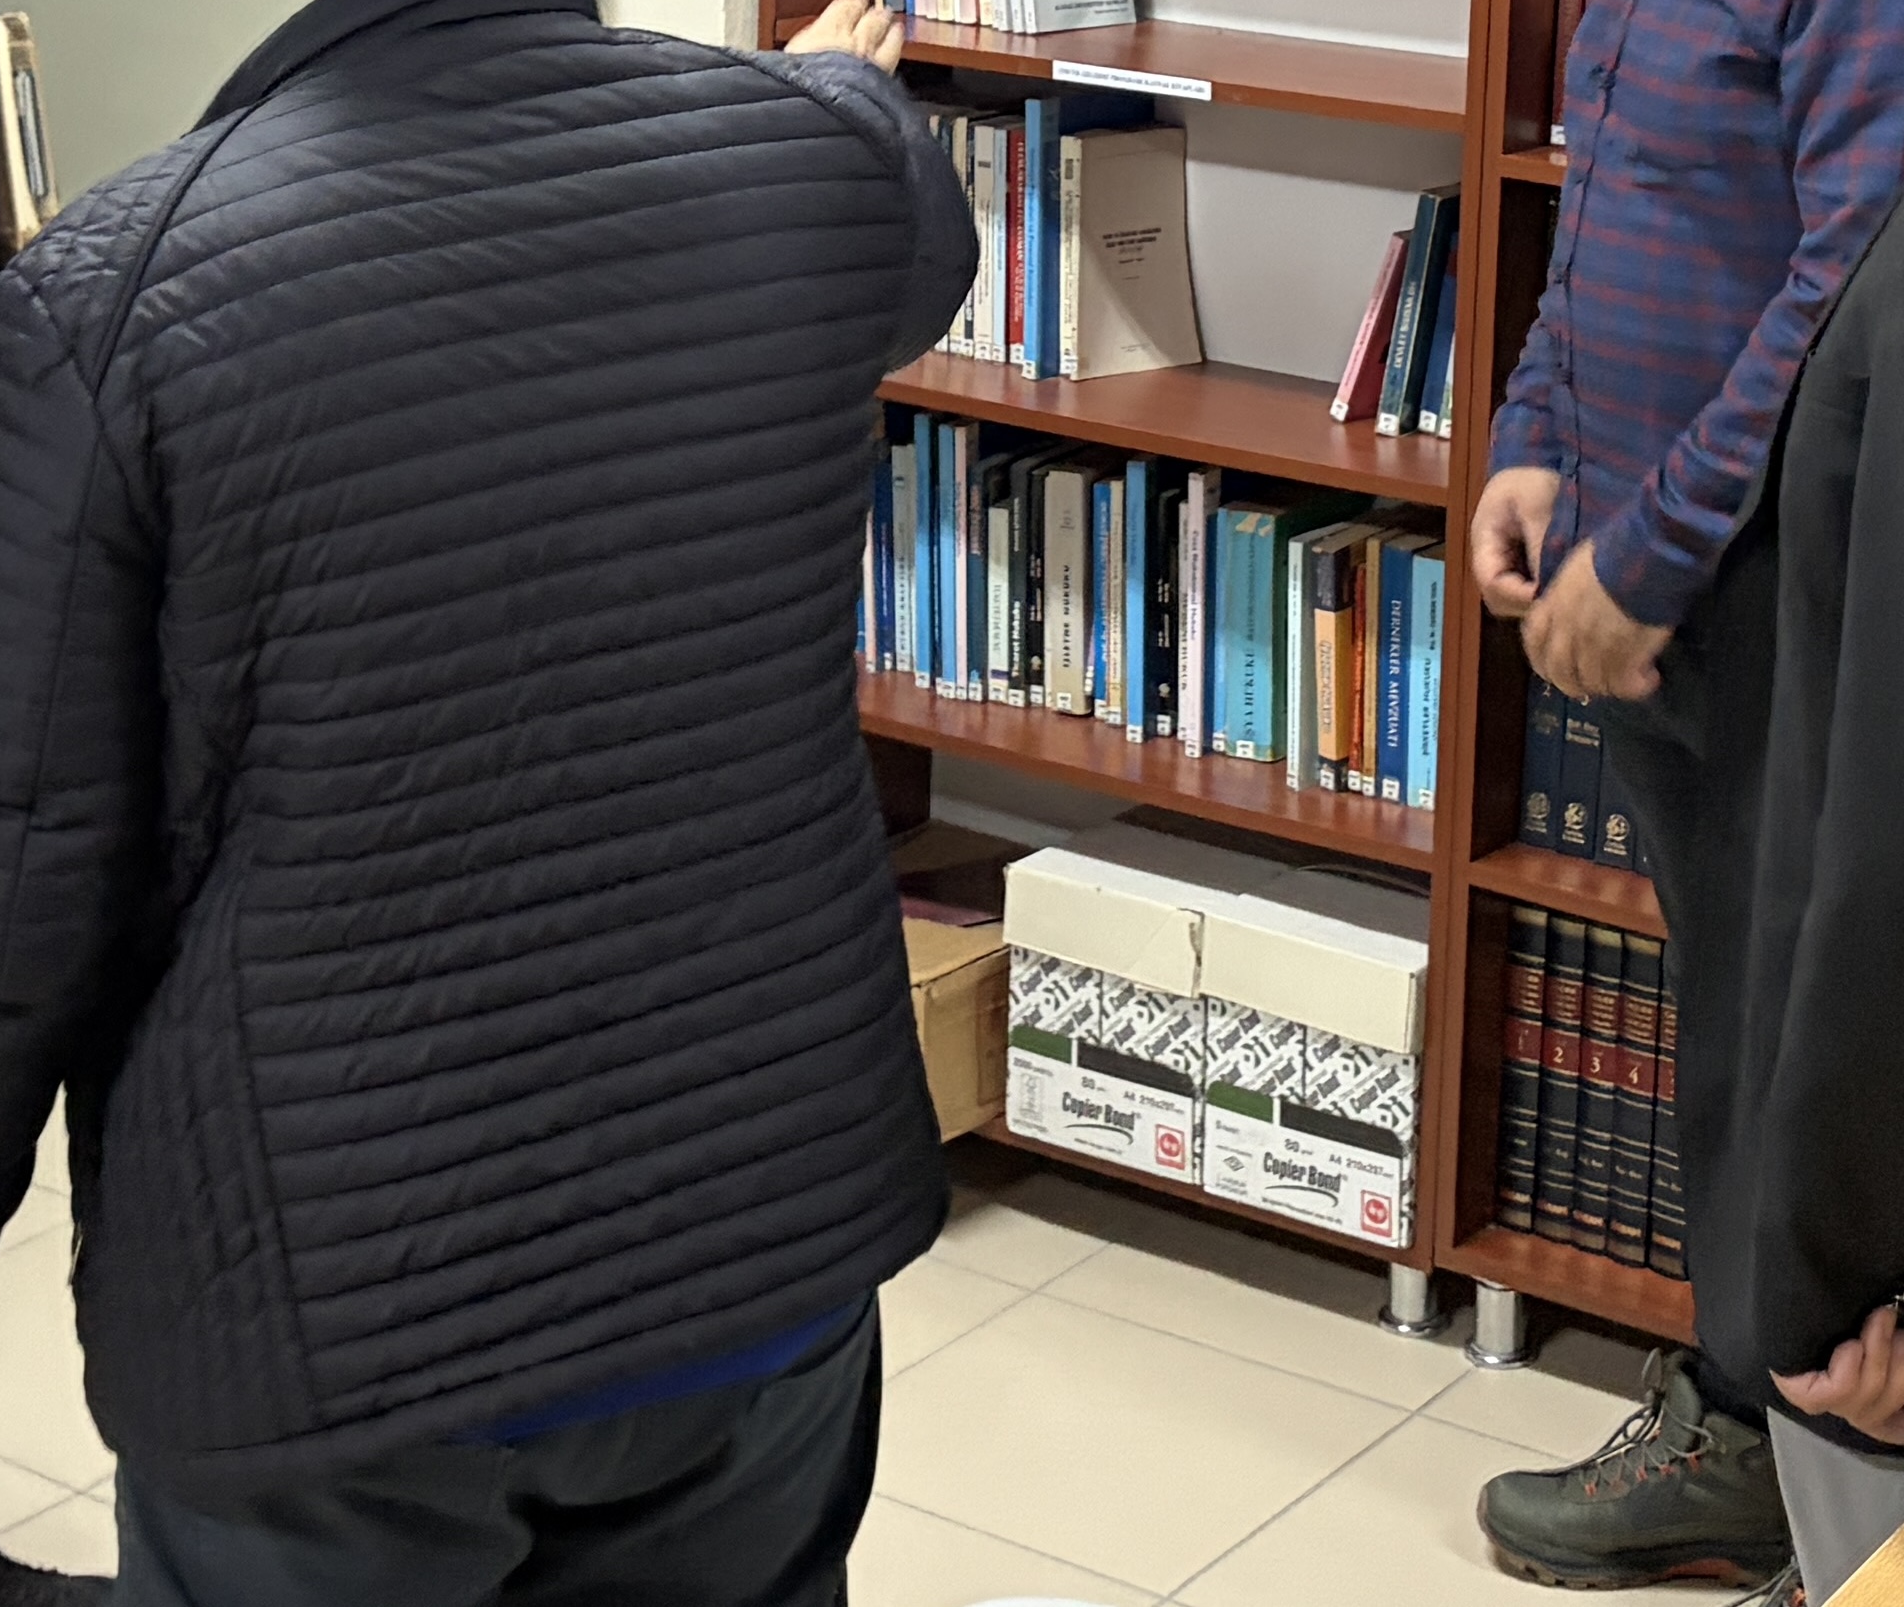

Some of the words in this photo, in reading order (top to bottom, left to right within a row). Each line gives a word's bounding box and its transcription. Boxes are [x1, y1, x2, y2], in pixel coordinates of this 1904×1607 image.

[1389, 599, 1403, 675] DERNEKLER
[1386, 680, 1400, 748] MEVZUATI
[1552, 1046, 1564, 1065] 2
[1590, 1056, 1601, 1074] 3
[1062, 1091, 1103, 1121] Copier
[1263, 1152, 1306, 1182] Copier
